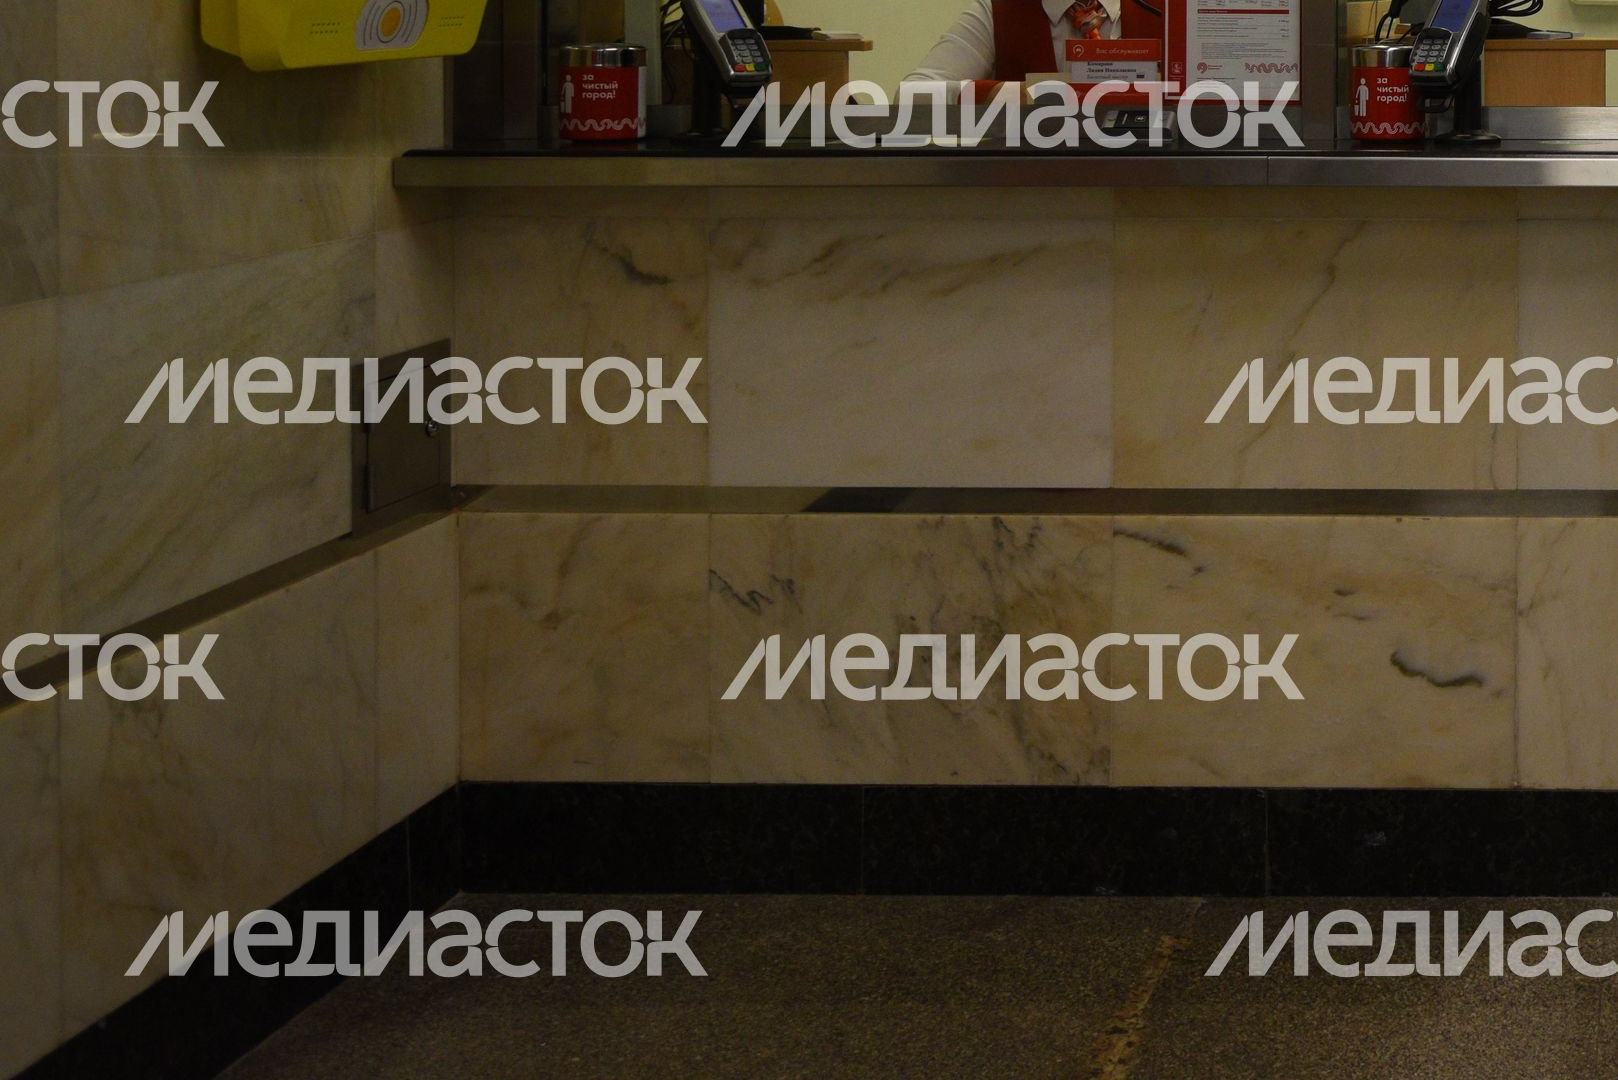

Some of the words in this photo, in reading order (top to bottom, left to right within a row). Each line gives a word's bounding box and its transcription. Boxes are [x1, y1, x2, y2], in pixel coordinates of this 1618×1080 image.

[582, 80, 619, 89] чистый
[1376, 84, 1410, 93] чистый
[582, 89, 616, 101] город!
[1376, 93, 1408, 104] город!
